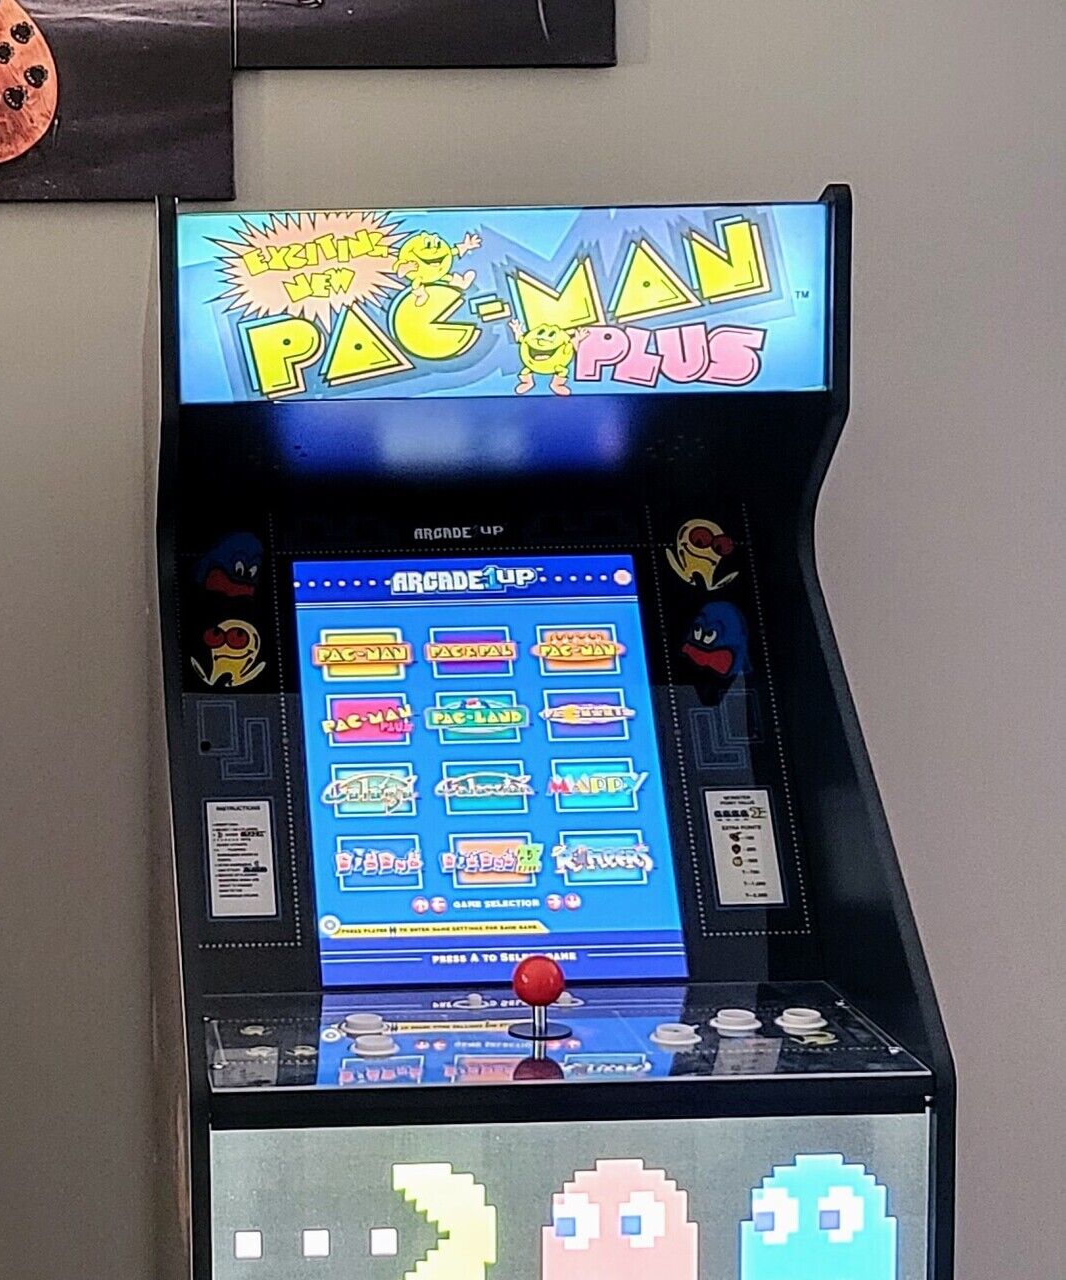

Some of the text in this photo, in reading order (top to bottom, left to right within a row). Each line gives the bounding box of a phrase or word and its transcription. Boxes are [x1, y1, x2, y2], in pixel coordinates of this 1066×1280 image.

[243, 228, 389, 276] EXCITING
[282, 267, 356, 303] NEW
[239, 217, 773, 398] PAC-MAN
[572, 323, 765, 388] PLUS
[318, 646, 407, 662] PAC-MAN
[540, 644, 616, 657] PAC-MAN
[322, 704, 413, 734] PAC-MAN
[432, 710, 523, 725] PAC-LAND
[547, 771, 650, 798] MAPPY
[453, 898, 540, 909] GAME SELECTION
[432, 954, 467, 963] PRESS
[470, 953, 479, 962] A
[482, 954, 498, 962] TO
